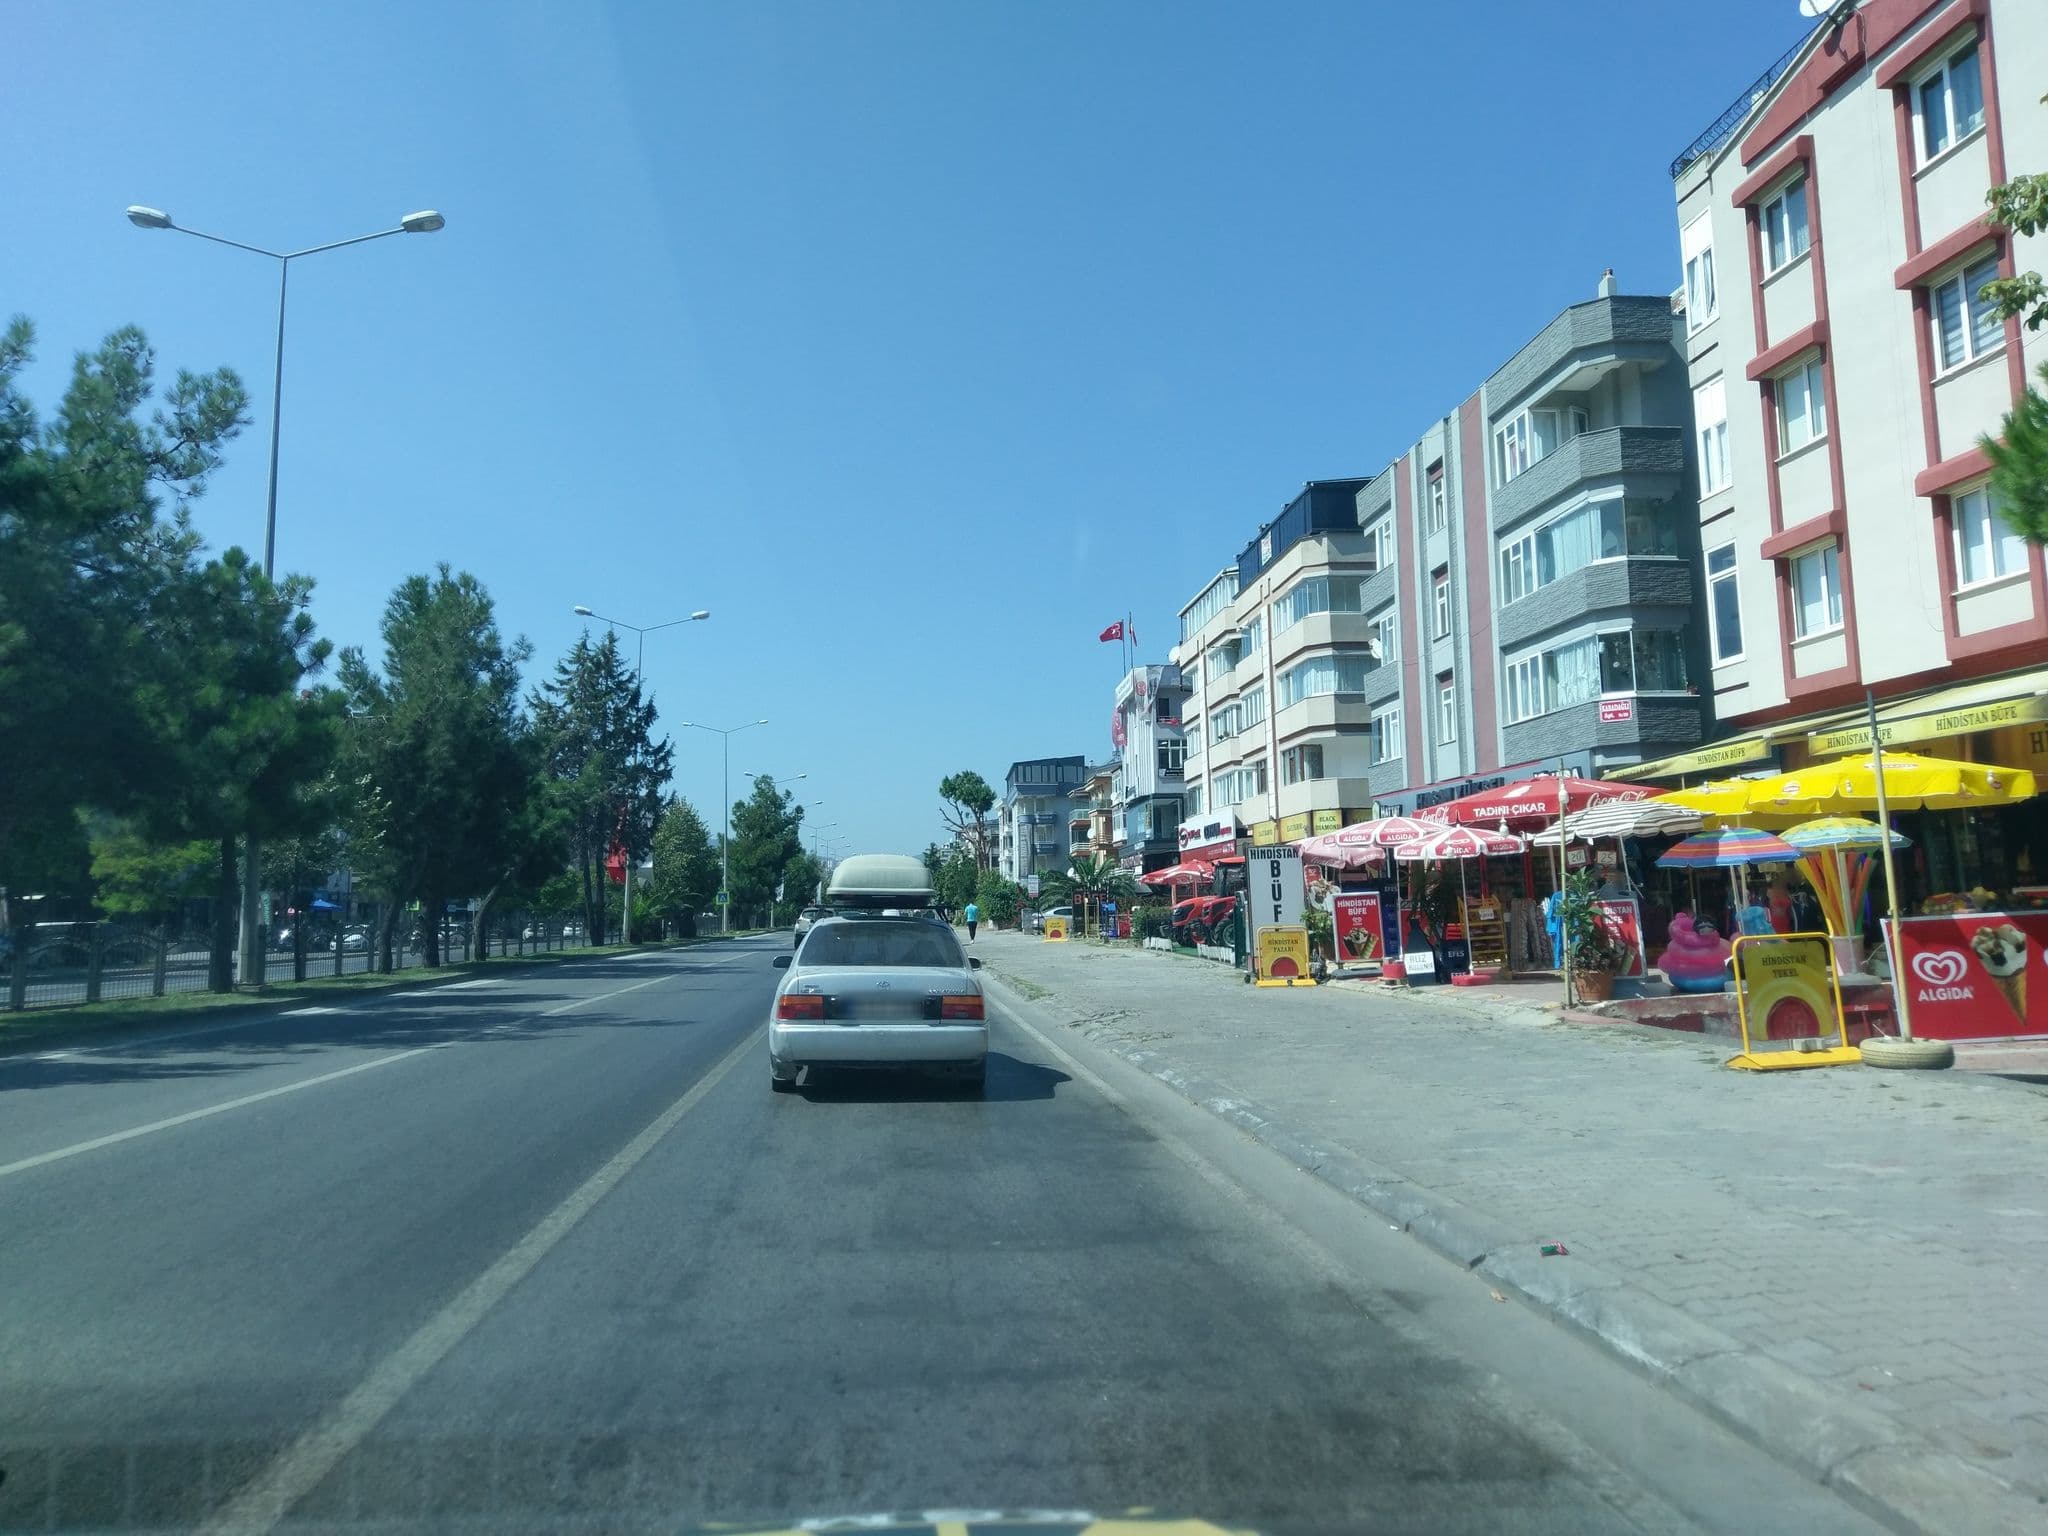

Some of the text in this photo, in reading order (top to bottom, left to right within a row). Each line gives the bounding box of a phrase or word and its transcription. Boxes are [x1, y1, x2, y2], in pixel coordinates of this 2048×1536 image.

[1936, 706, 2017, 730] HİNDİSTAN BÜFE
[1827, 732, 1869, 748] HİNDİSTAN
[1697, 747, 1746, 764] HİNDİSTAN BÜFE
[1512, 802, 1546, 815] ÇIKAR
[1270, 859, 1283, 922] BÜF
[1337, 898, 1376, 908] HİNDİSTAN
[1348, 907, 1367, 916] BÜFE
